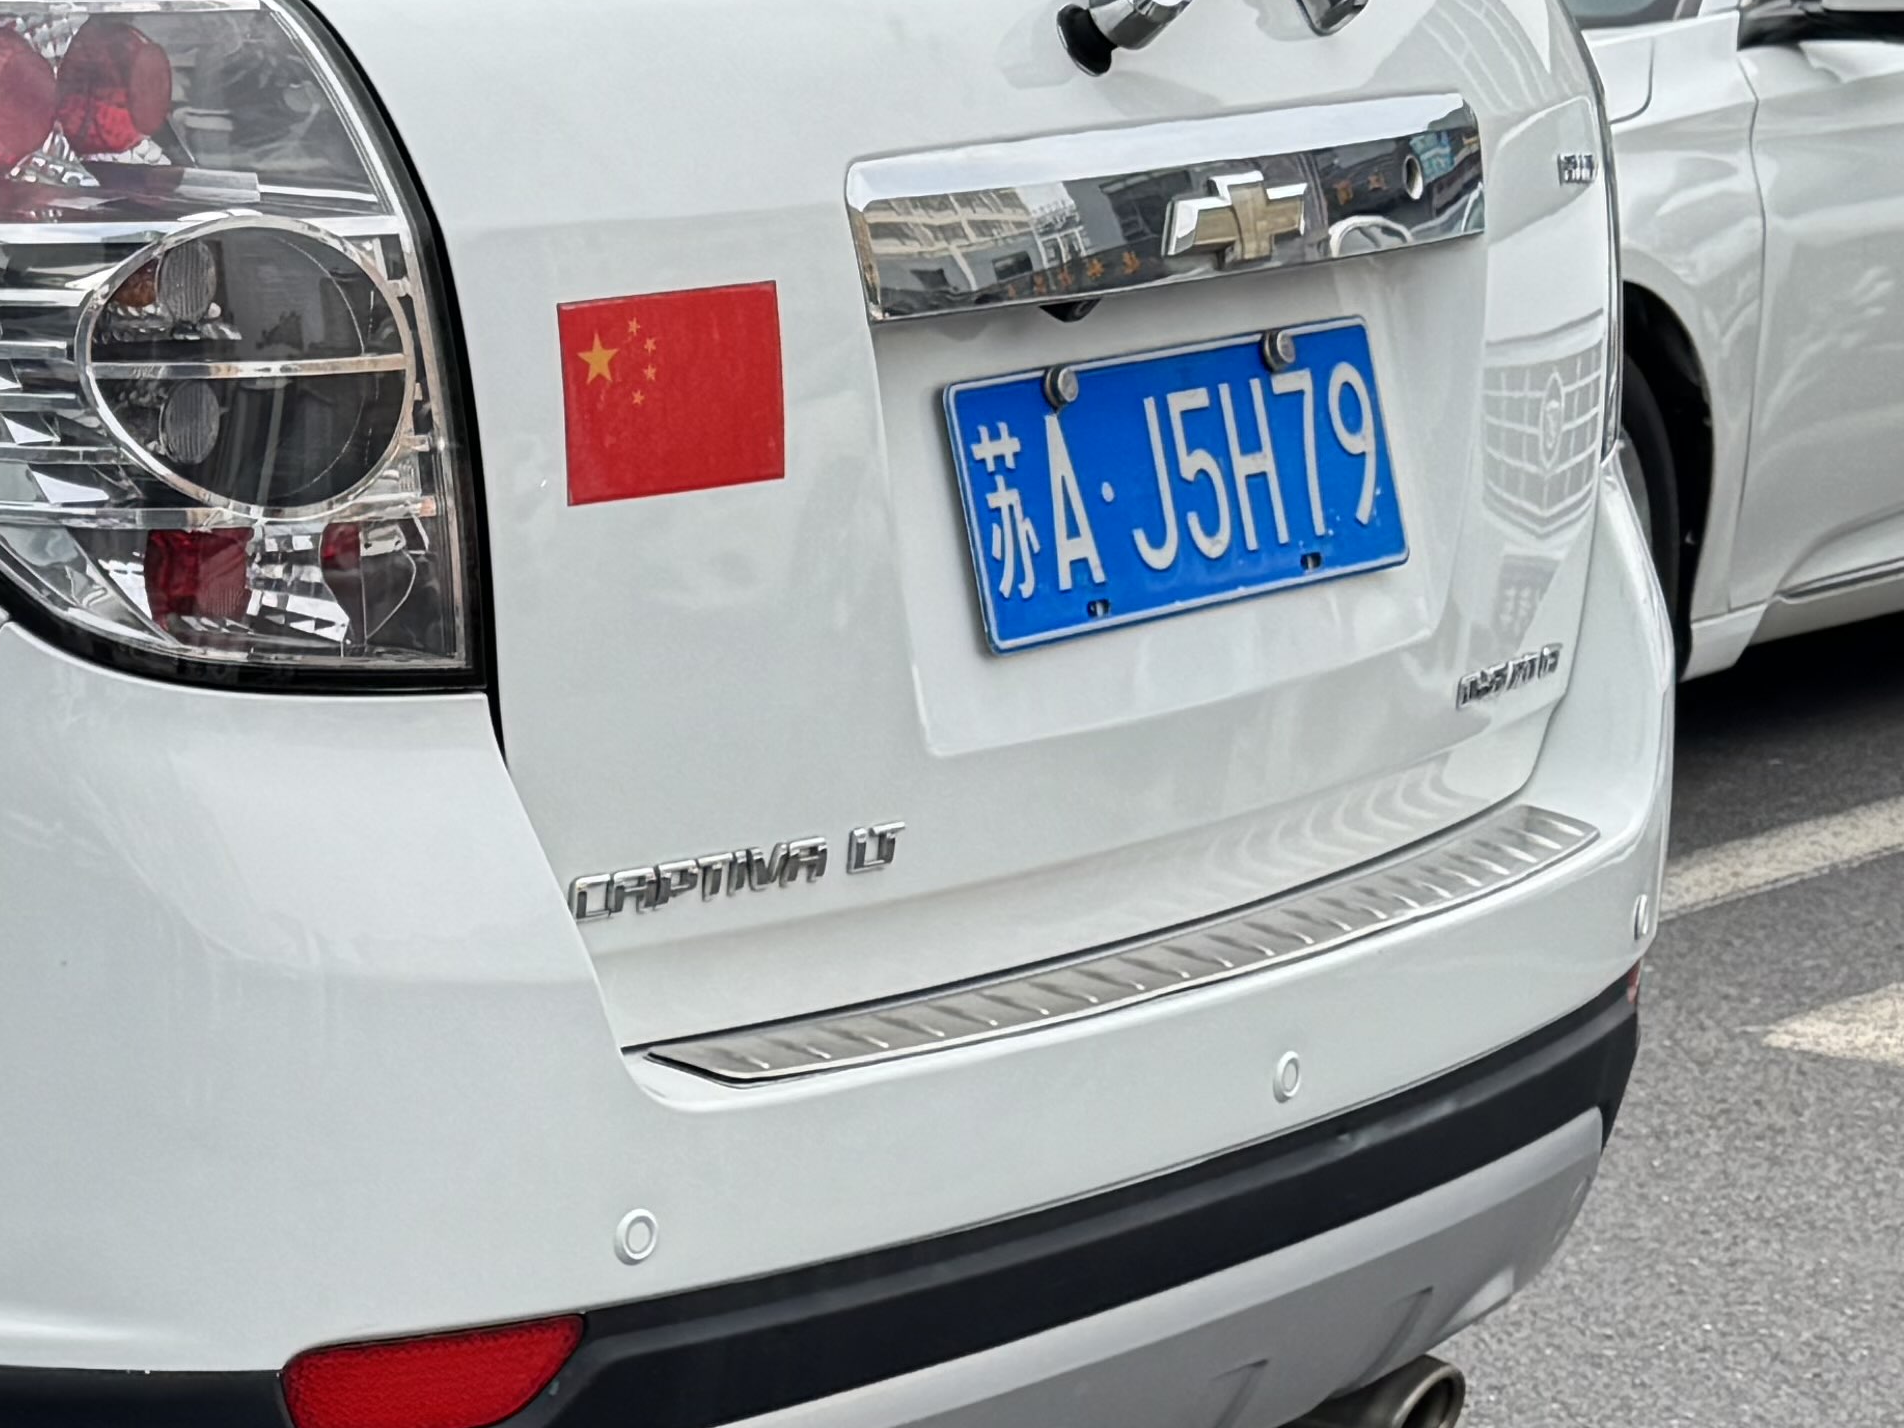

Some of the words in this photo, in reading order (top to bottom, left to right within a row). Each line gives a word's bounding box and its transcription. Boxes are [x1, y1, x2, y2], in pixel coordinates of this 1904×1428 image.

[970, 360, 1378, 600] 苏A·J5H79
[567, 835, 829, 923] CAPTIVA
[845, 820, 907, 875] LT
